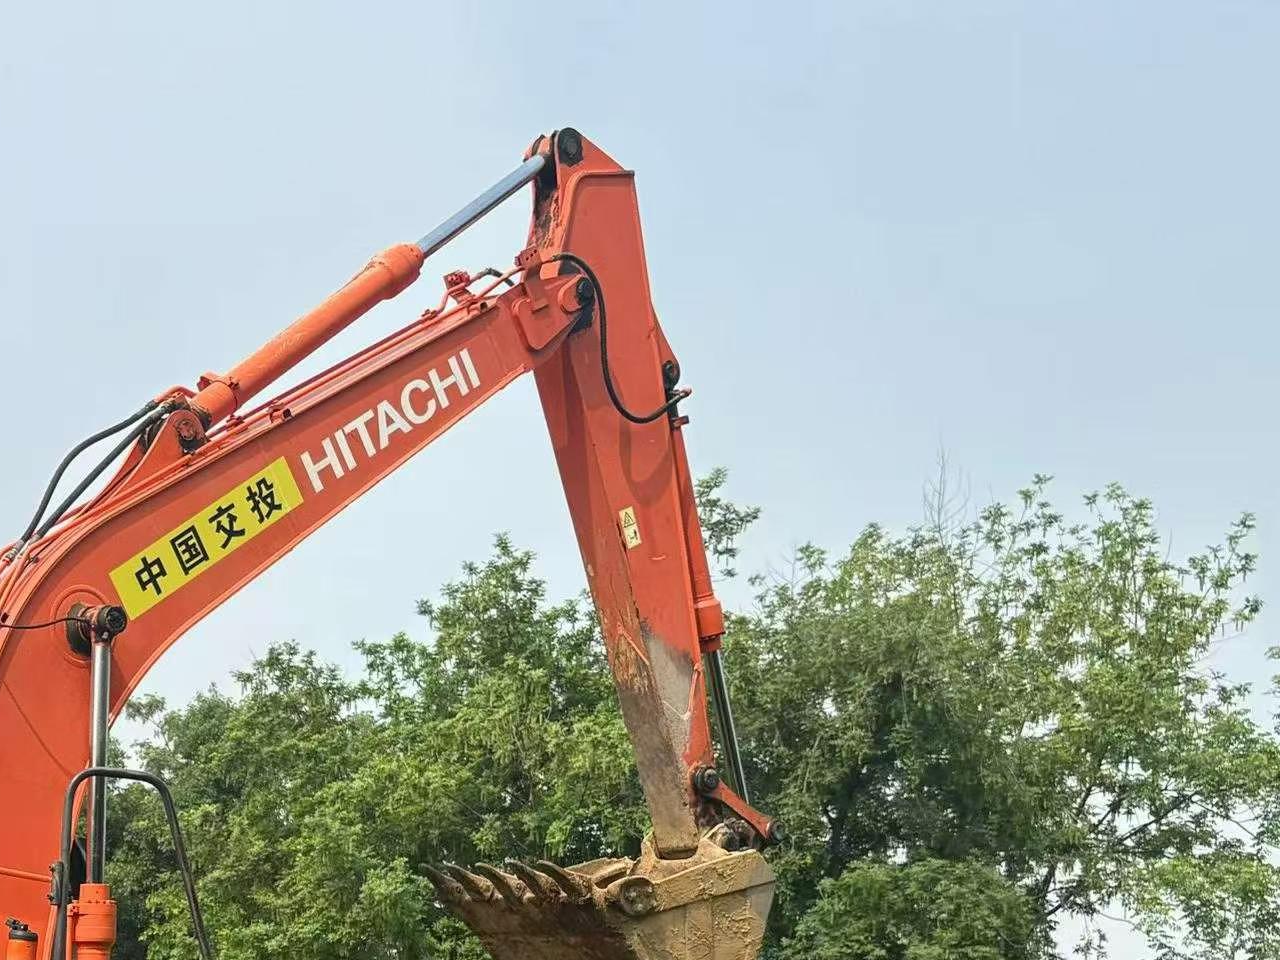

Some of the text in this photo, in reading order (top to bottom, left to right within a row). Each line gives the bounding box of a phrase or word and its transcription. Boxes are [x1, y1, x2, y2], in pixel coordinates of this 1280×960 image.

[300, 348, 481, 493] HITACHI
[134, 477, 283, 596] 中国交投
